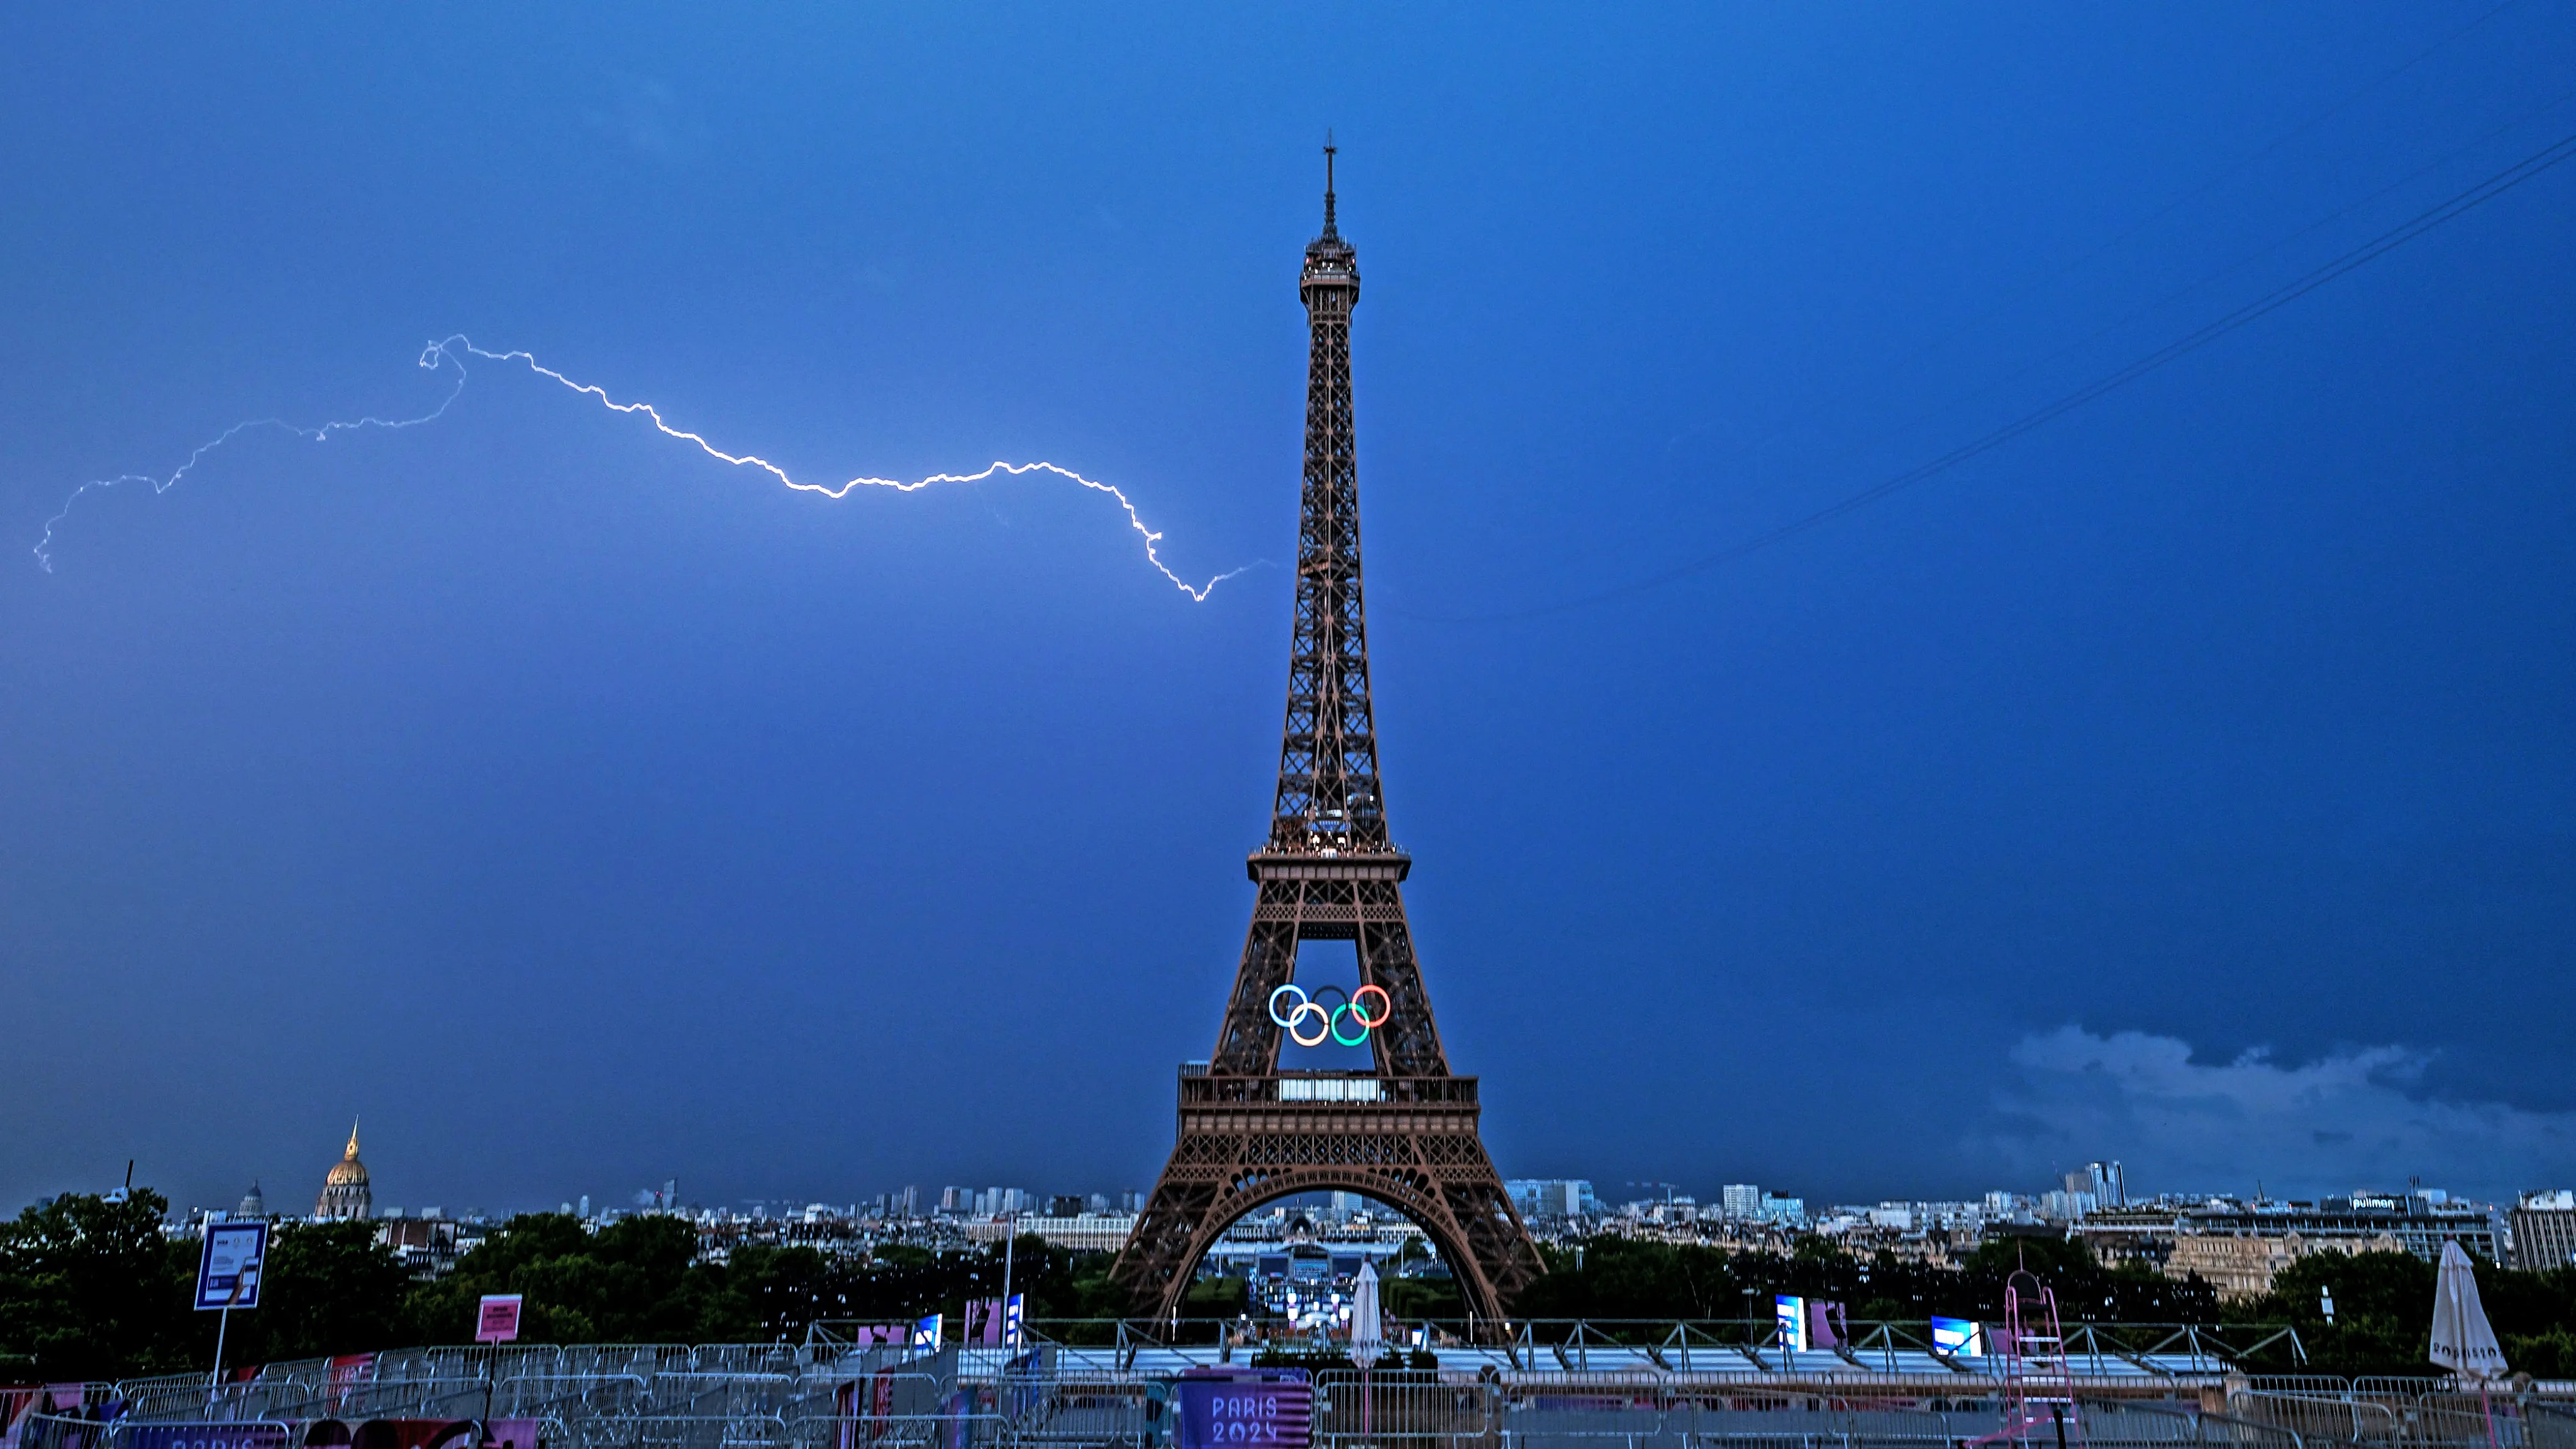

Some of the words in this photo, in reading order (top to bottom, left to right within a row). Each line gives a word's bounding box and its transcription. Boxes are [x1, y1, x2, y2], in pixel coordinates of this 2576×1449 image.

[2353, 1197, 2395, 1211] pullman
[1212, 1396, 1277, 1419] PARIS
[1213, 1421, 1277, 1443] 2024
